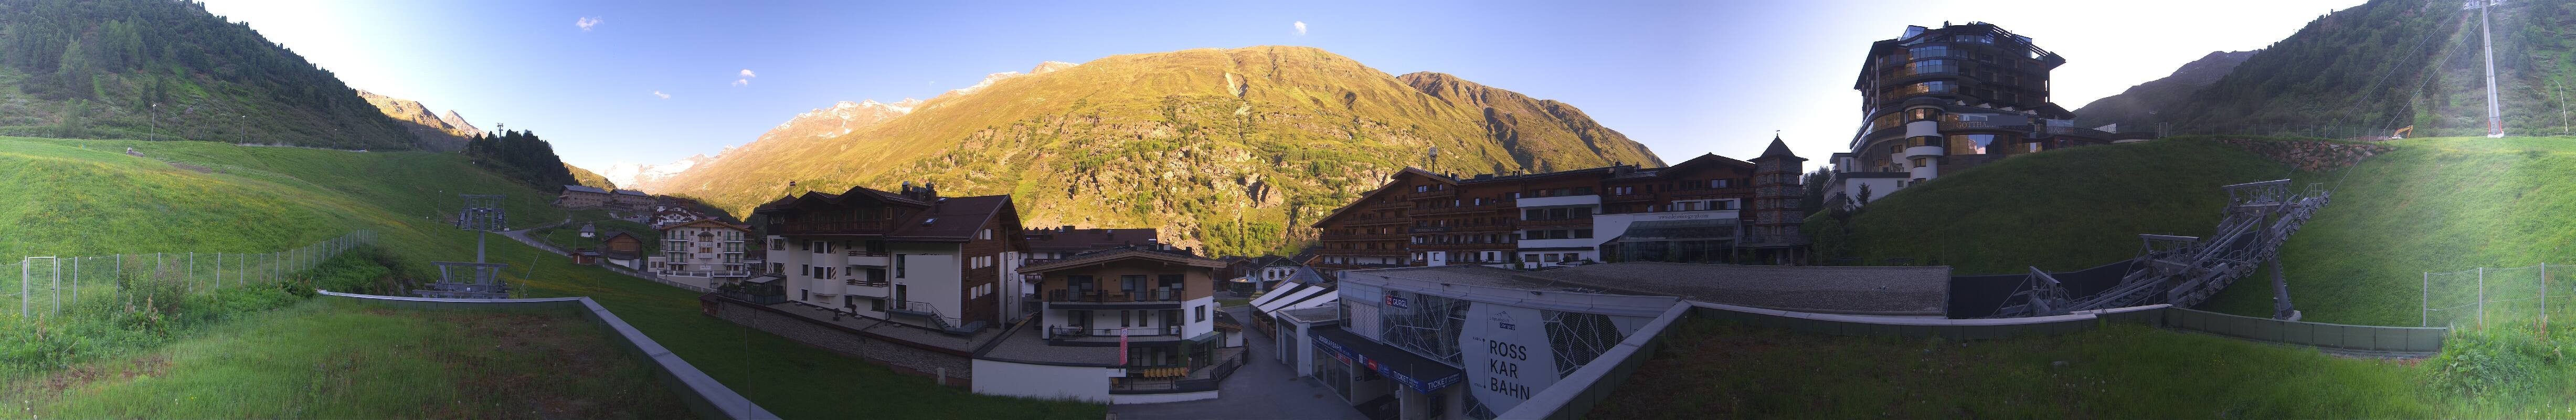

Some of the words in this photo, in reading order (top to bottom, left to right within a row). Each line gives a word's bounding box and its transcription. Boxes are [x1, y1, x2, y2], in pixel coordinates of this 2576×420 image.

[1393, 298, 1407, 308] GURGL
[1319, 334, 1342, 352] ROSSKARBAHN
[1490, 340, 1527, 361] ROSS
[1393, 371, 1409, 383] TICKET
[1490, 358, 1518, 379] KAR
[1427, 377, 1448, 390] TICKET
[1491, 377, 1530, 400] BAHN
